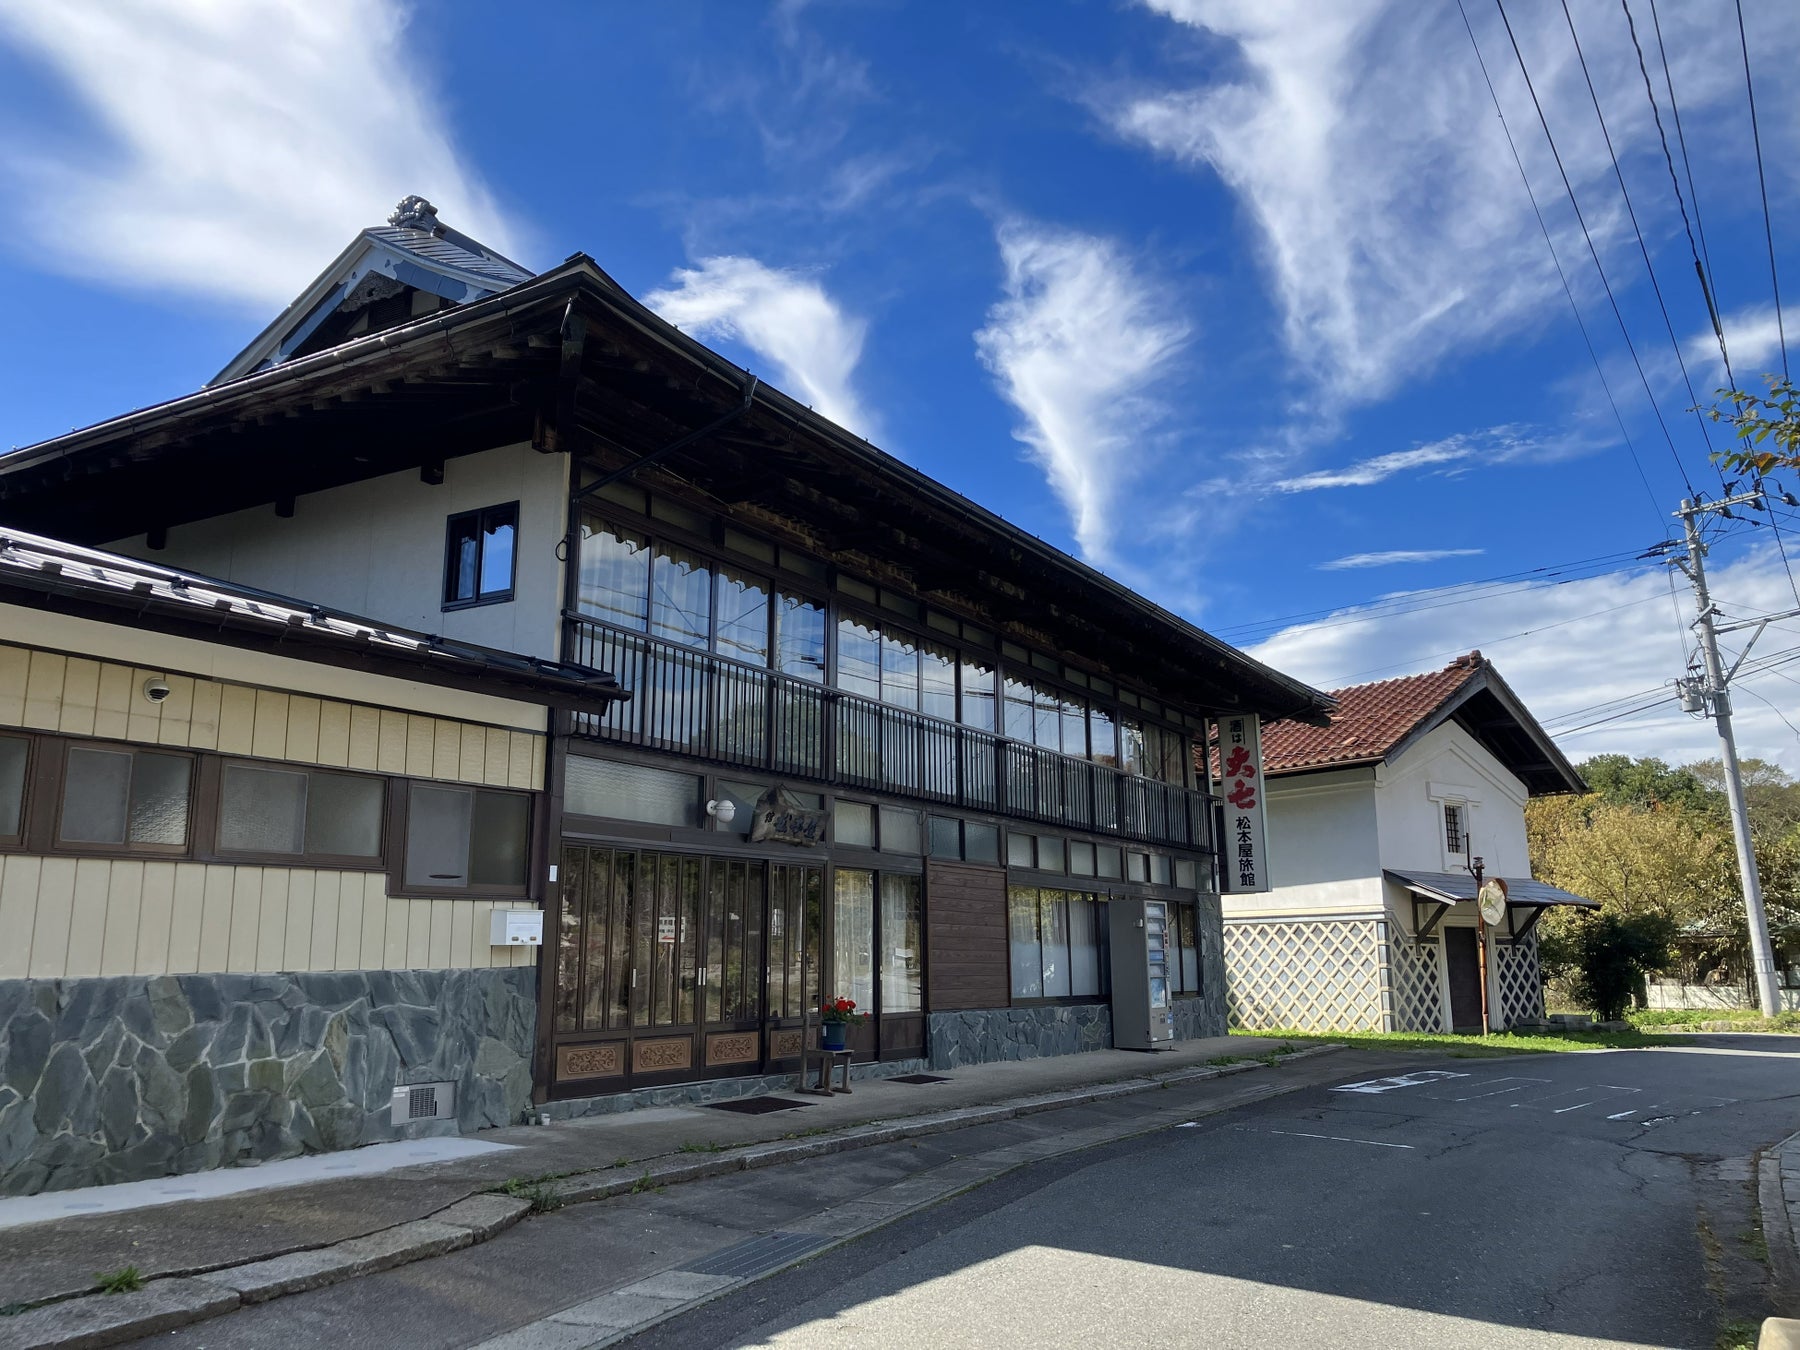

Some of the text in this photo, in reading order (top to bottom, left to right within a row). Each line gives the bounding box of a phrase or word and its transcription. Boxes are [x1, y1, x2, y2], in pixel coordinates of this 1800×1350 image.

[1230, 720, 1243, 744] 酒は
[1236, 816, 1255, 887] 松本屋旅館
